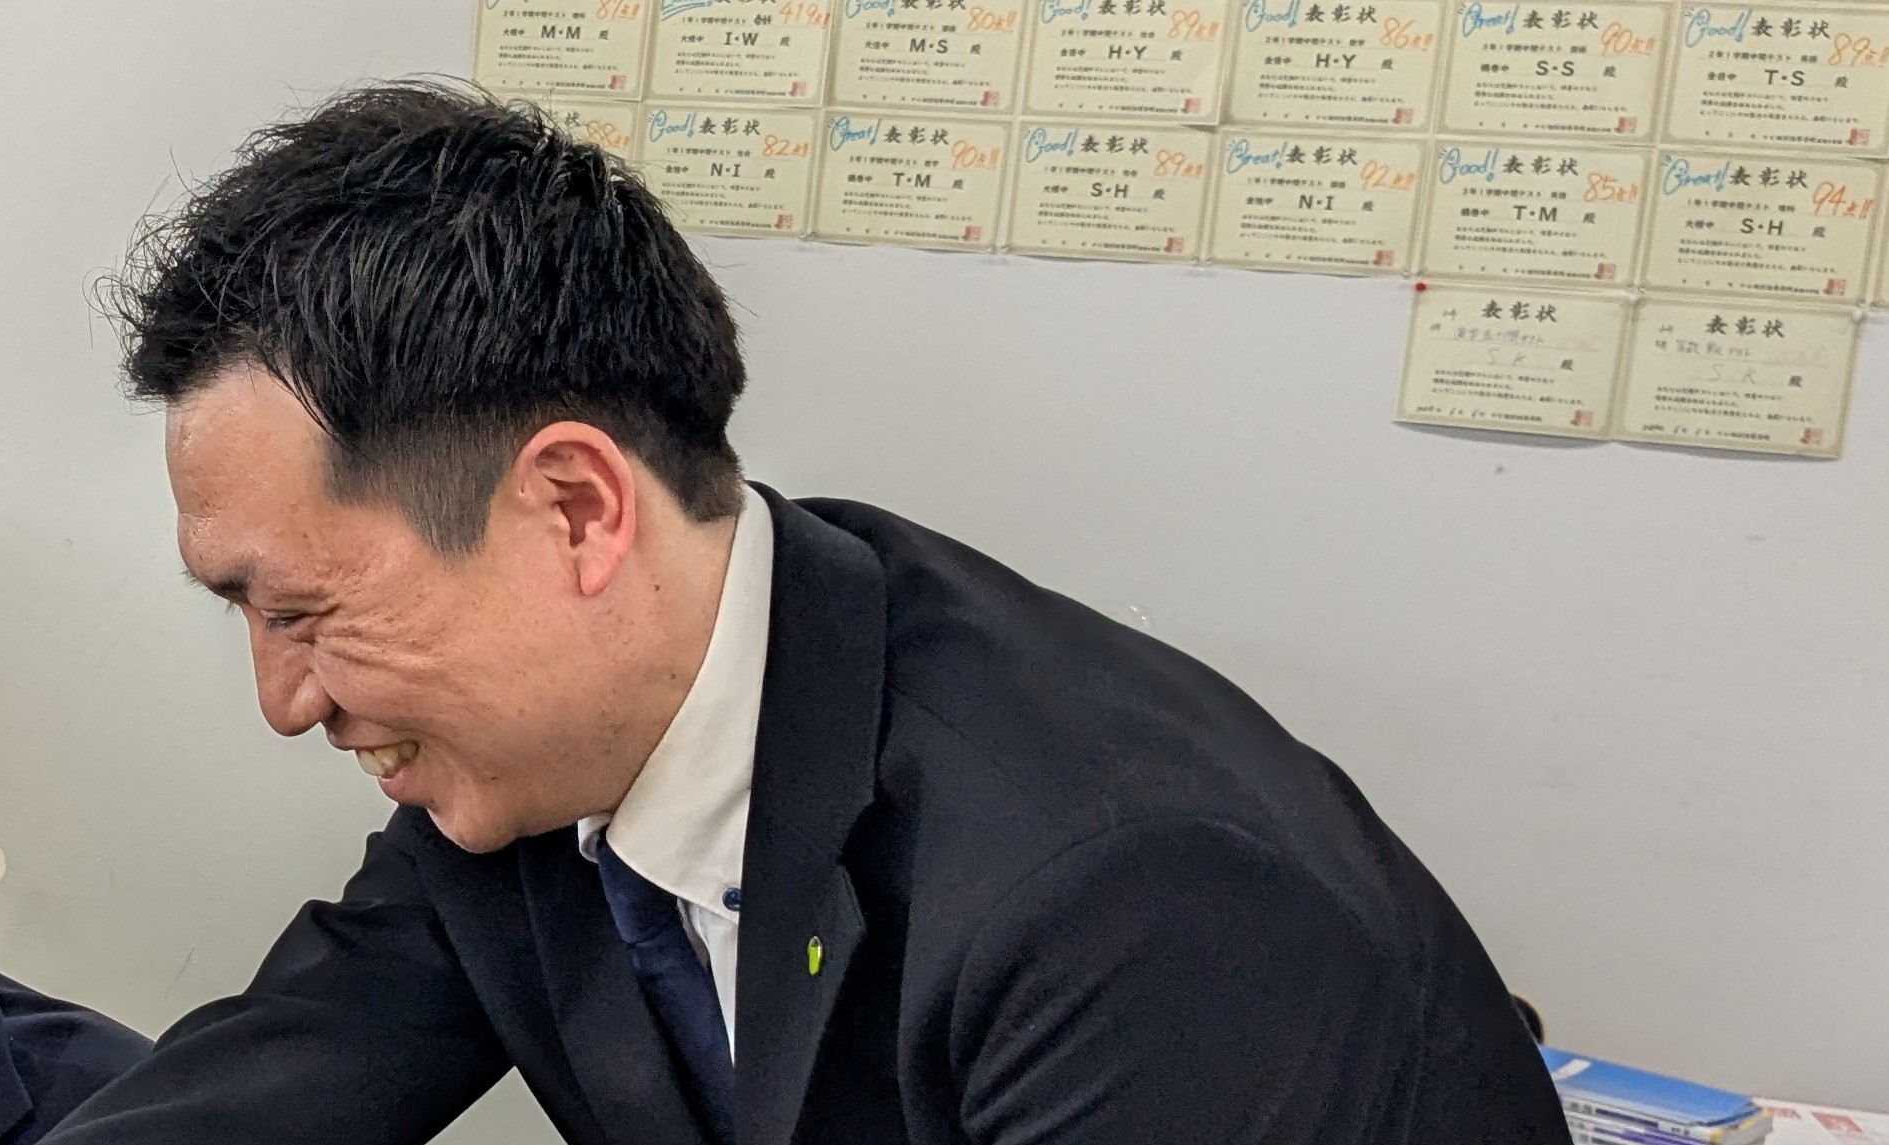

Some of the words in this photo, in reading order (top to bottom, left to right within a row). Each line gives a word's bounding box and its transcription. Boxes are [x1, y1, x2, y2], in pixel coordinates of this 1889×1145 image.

[1098, 0, 1166, 16] 表彰状
[1305, 3, 1378, 24] 表彰状
[1523, 10, 1599, 30] 表彰状
[1751, 17, 1830, 39] 表彰状
[699, 117, 761, 136] 表彰状
[884, 125, 949, 145] 表彰状
[1081, 135, 1149, 155] 表彰状
[1286, 145, 1358, 166] 表彰状
[1503, 155, 1579, 177] 表彰状
[1730, 166, 1809, 189] 表彰状
[1482, 300, 1557, 322] 表彰状
[1706, 314, 1784, 338] 表彰状
